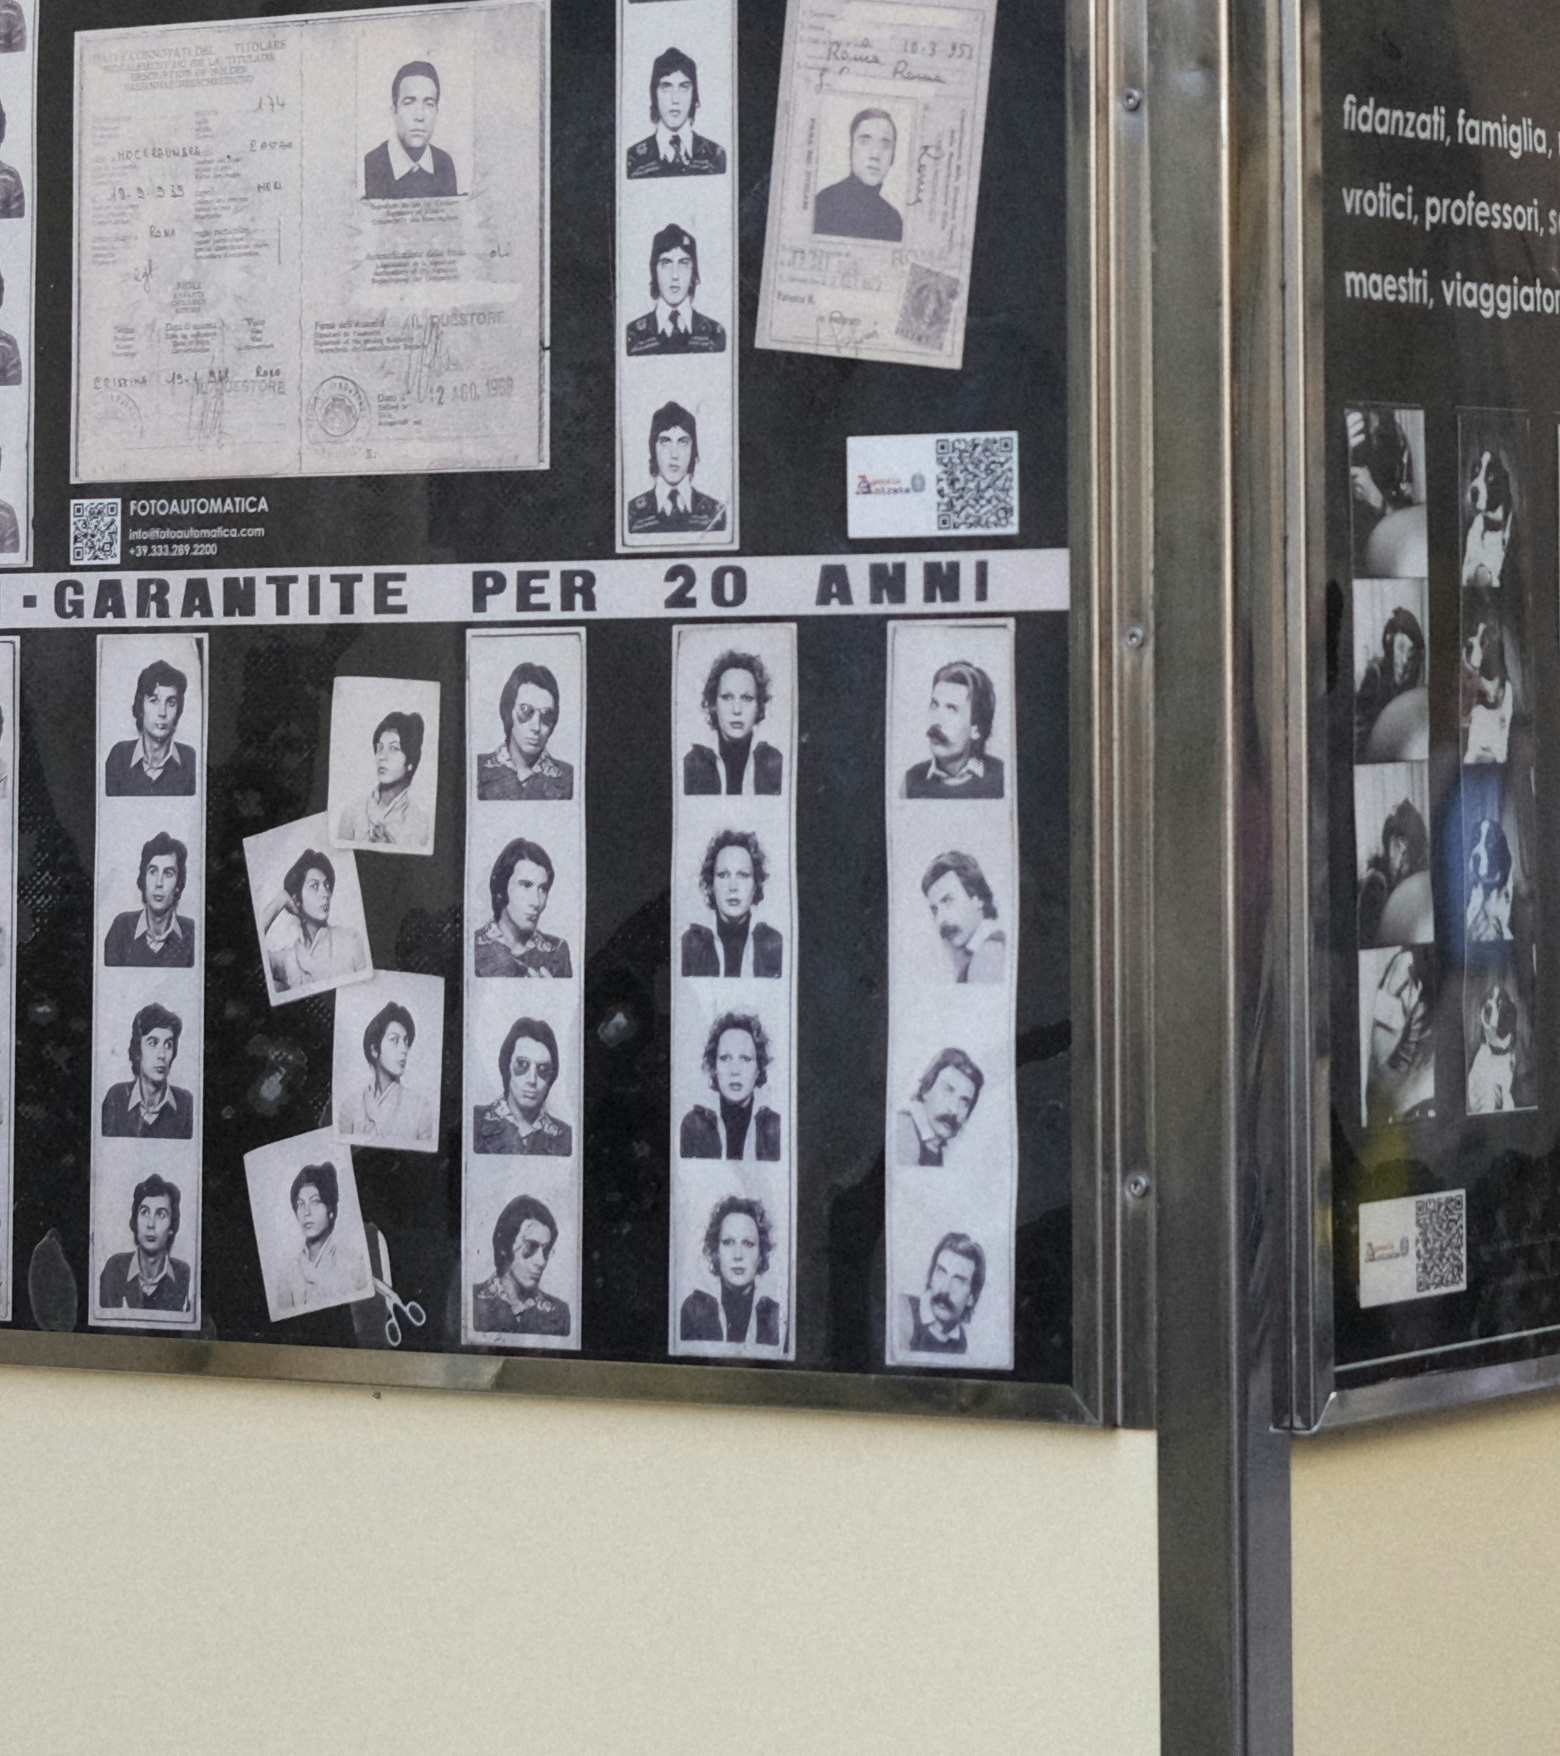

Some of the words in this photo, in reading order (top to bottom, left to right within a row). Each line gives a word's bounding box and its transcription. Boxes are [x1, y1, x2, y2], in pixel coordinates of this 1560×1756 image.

[1342, 93, 1451, 146] fidanzati,
[1457, 108, 1554, 160] famiglia,
[1341, 182, 1420, 225] vrotici,
[1424, 190, 1545, 237] professori,
[1344, 268, 1434, 310] maestri,
[129, 496, 269, 516] FOTOAUTOMATICA
[52, 571, 409, 621] GARANTITE
[471, 568, 598, 614] PER
[663, 563, 749, 610] 20
[815, 558, 990, 605] ANNI
